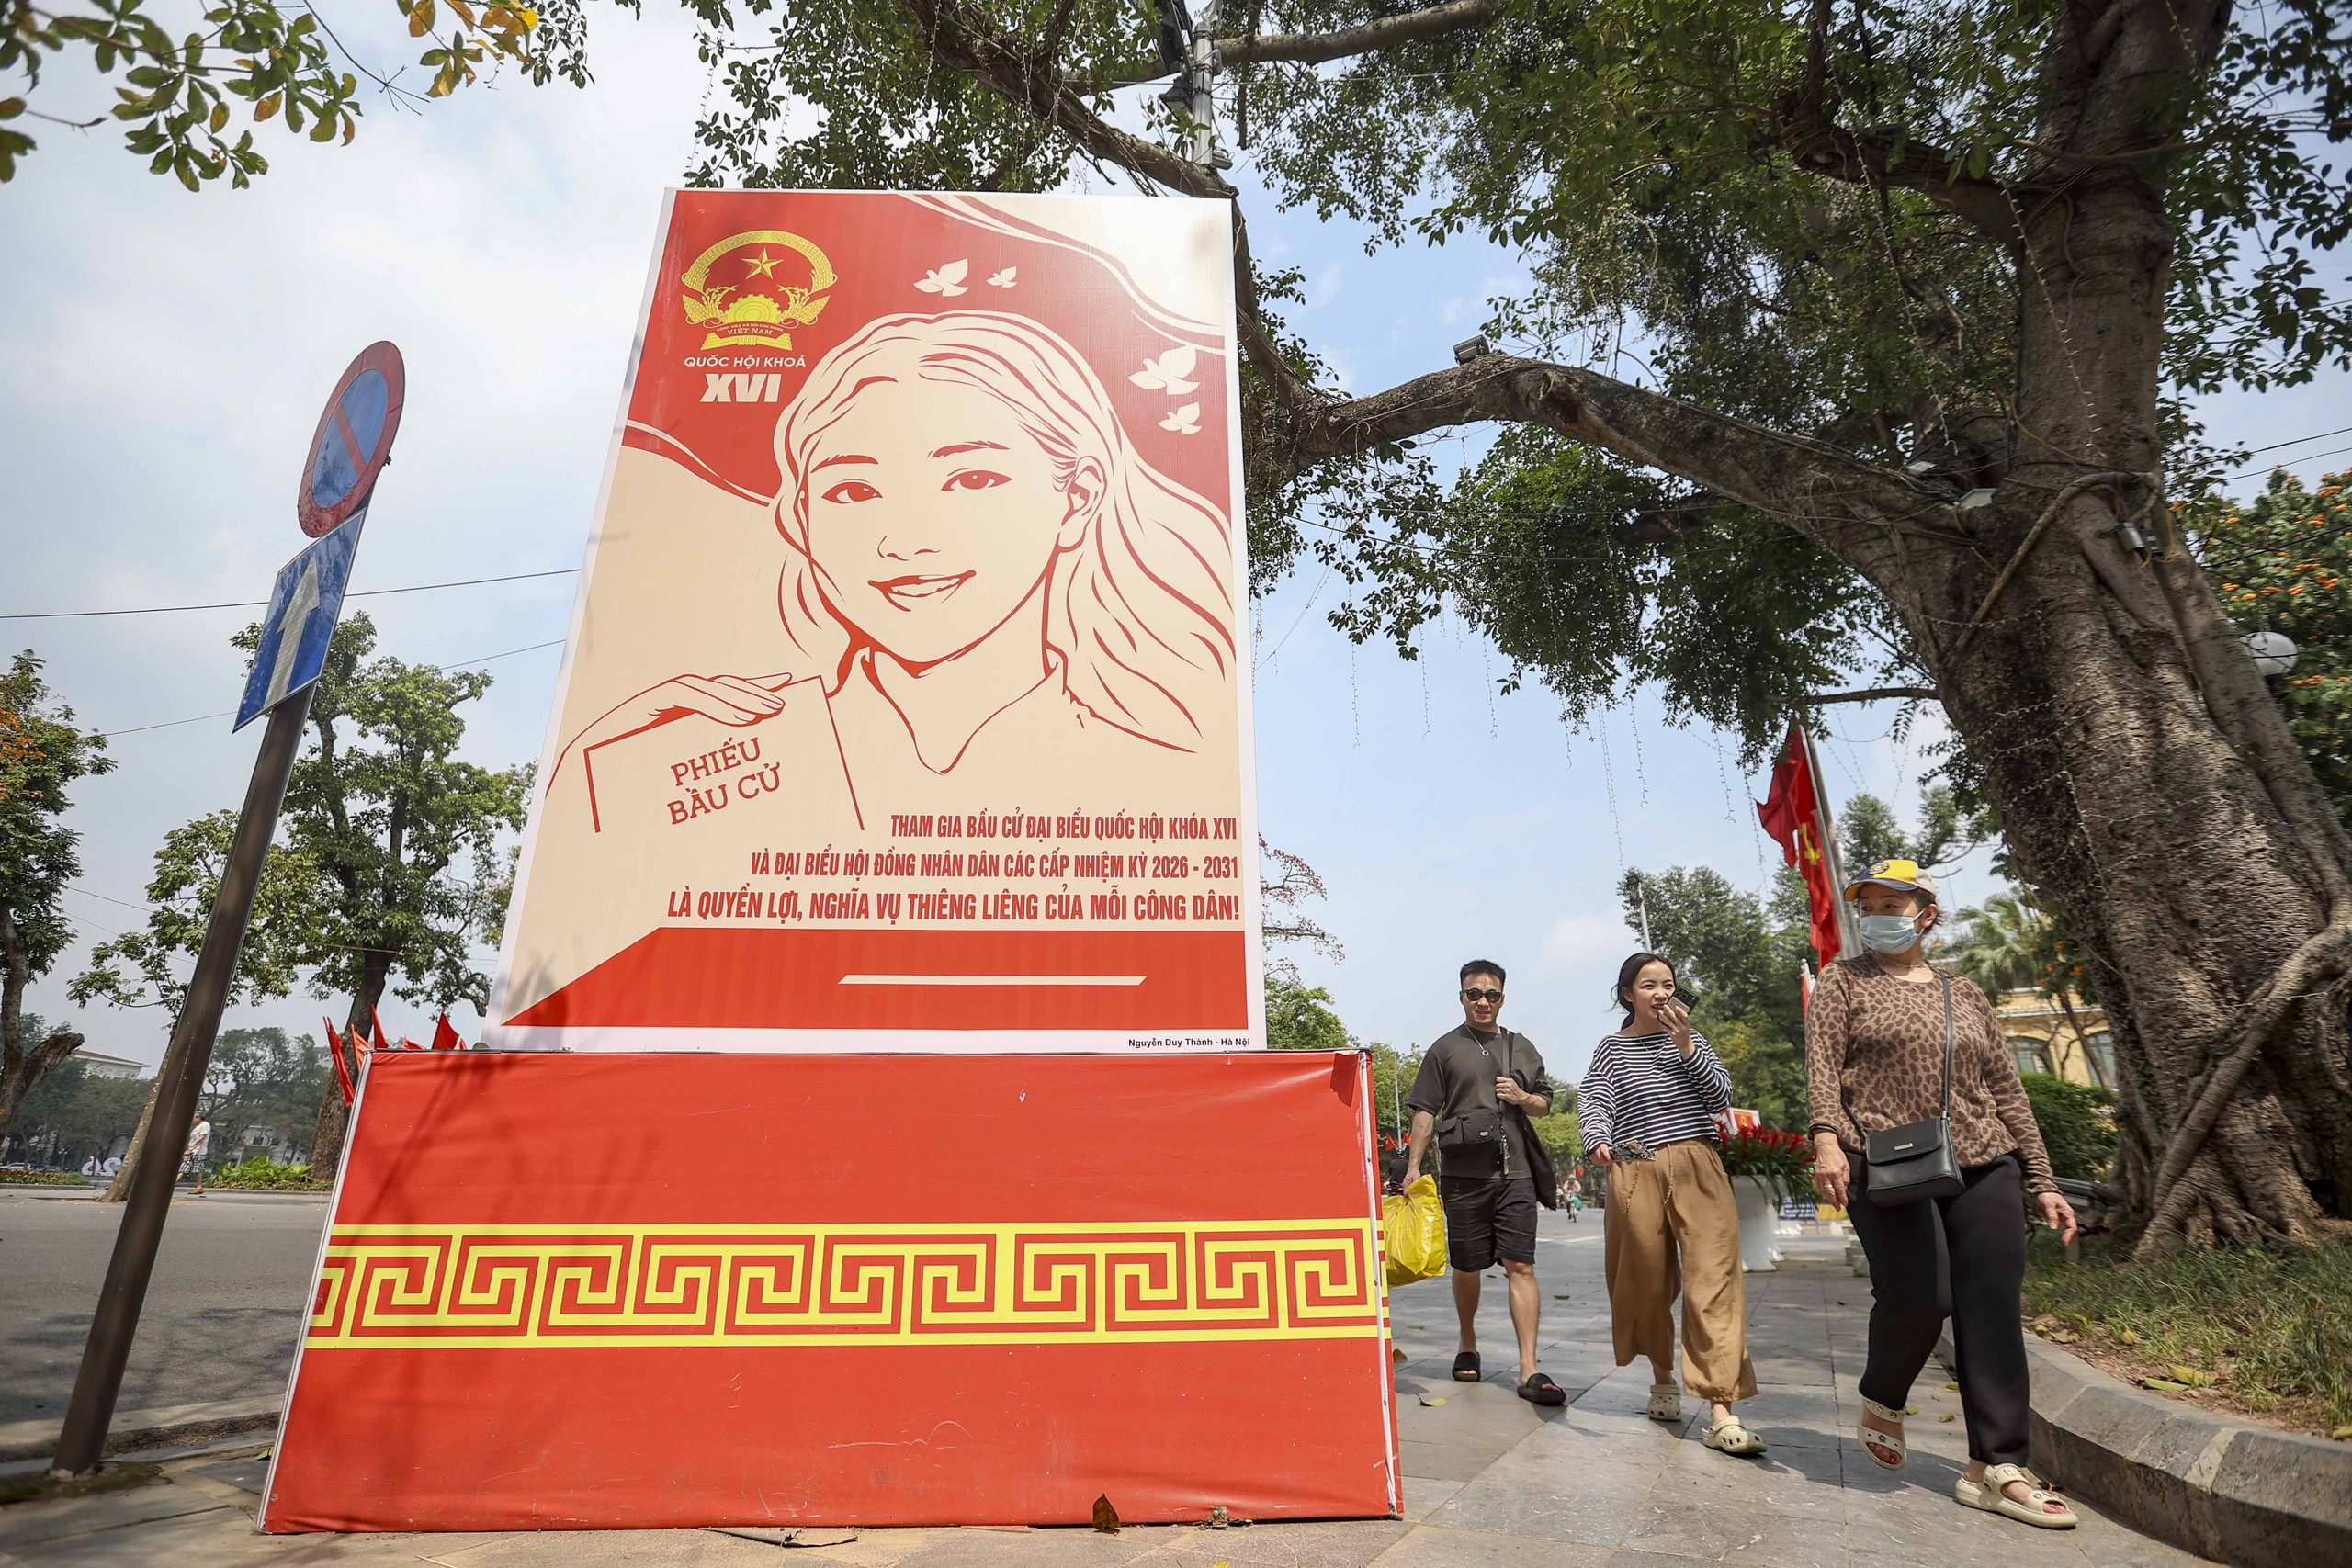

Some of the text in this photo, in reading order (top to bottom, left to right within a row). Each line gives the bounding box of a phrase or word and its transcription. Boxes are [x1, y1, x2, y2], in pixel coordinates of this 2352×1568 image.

[727, 327, 750, 335] VIỆT
[684, 353, 807, 370] QUỐC HỘI KHOÁ
[700, 374, 781, 402] XVI
[670, 737, 761, 786] PHIẾU
[667, 761, 780, 825] BẦU CỬ
[891, 808, 1237, 843] THAM GIA BẦU CỬ ĐẠI BIỂU QUỐC HỘI KHÓA XVI
[752, 847, 770, 875] VÀ
[775, 852, 800, 880] ĐẠI
[804, 844, 840, 876] BIỂU
[843, 849, 870, 882] HỘI
[874, 847, 916, 876] ĐỒNG
[920, 850, 963, 876] NHÂN
[968, 850, 1000, 877] DÂN
[1004, 851, 1035, 877] CÁC
[1039, 846, 1070, 878] CẤP
[1075, 850, 1124, 883] NHIỆM
[1128, 851, 1148, 878] KỲ
[1152, 855, 1189, 878] 2026
[1204, 856, 1238, 879] 2031
[667, 883, 1239, 925] LÀ QUYỀN LỢI, NGHĨA VỤ THIÊNG LIÊNG CỦA MỖI CÔNG DÂN!
[1128, 1037, 1163, 1049] Nguyễn
[1165, 1038, 1182, 1048] Duy
[1184, 1038, 1213, 1046] Thành
[1220, 1037, 1233, 1046] Hà
[1235, 1037, 1250, 1048] Nội
